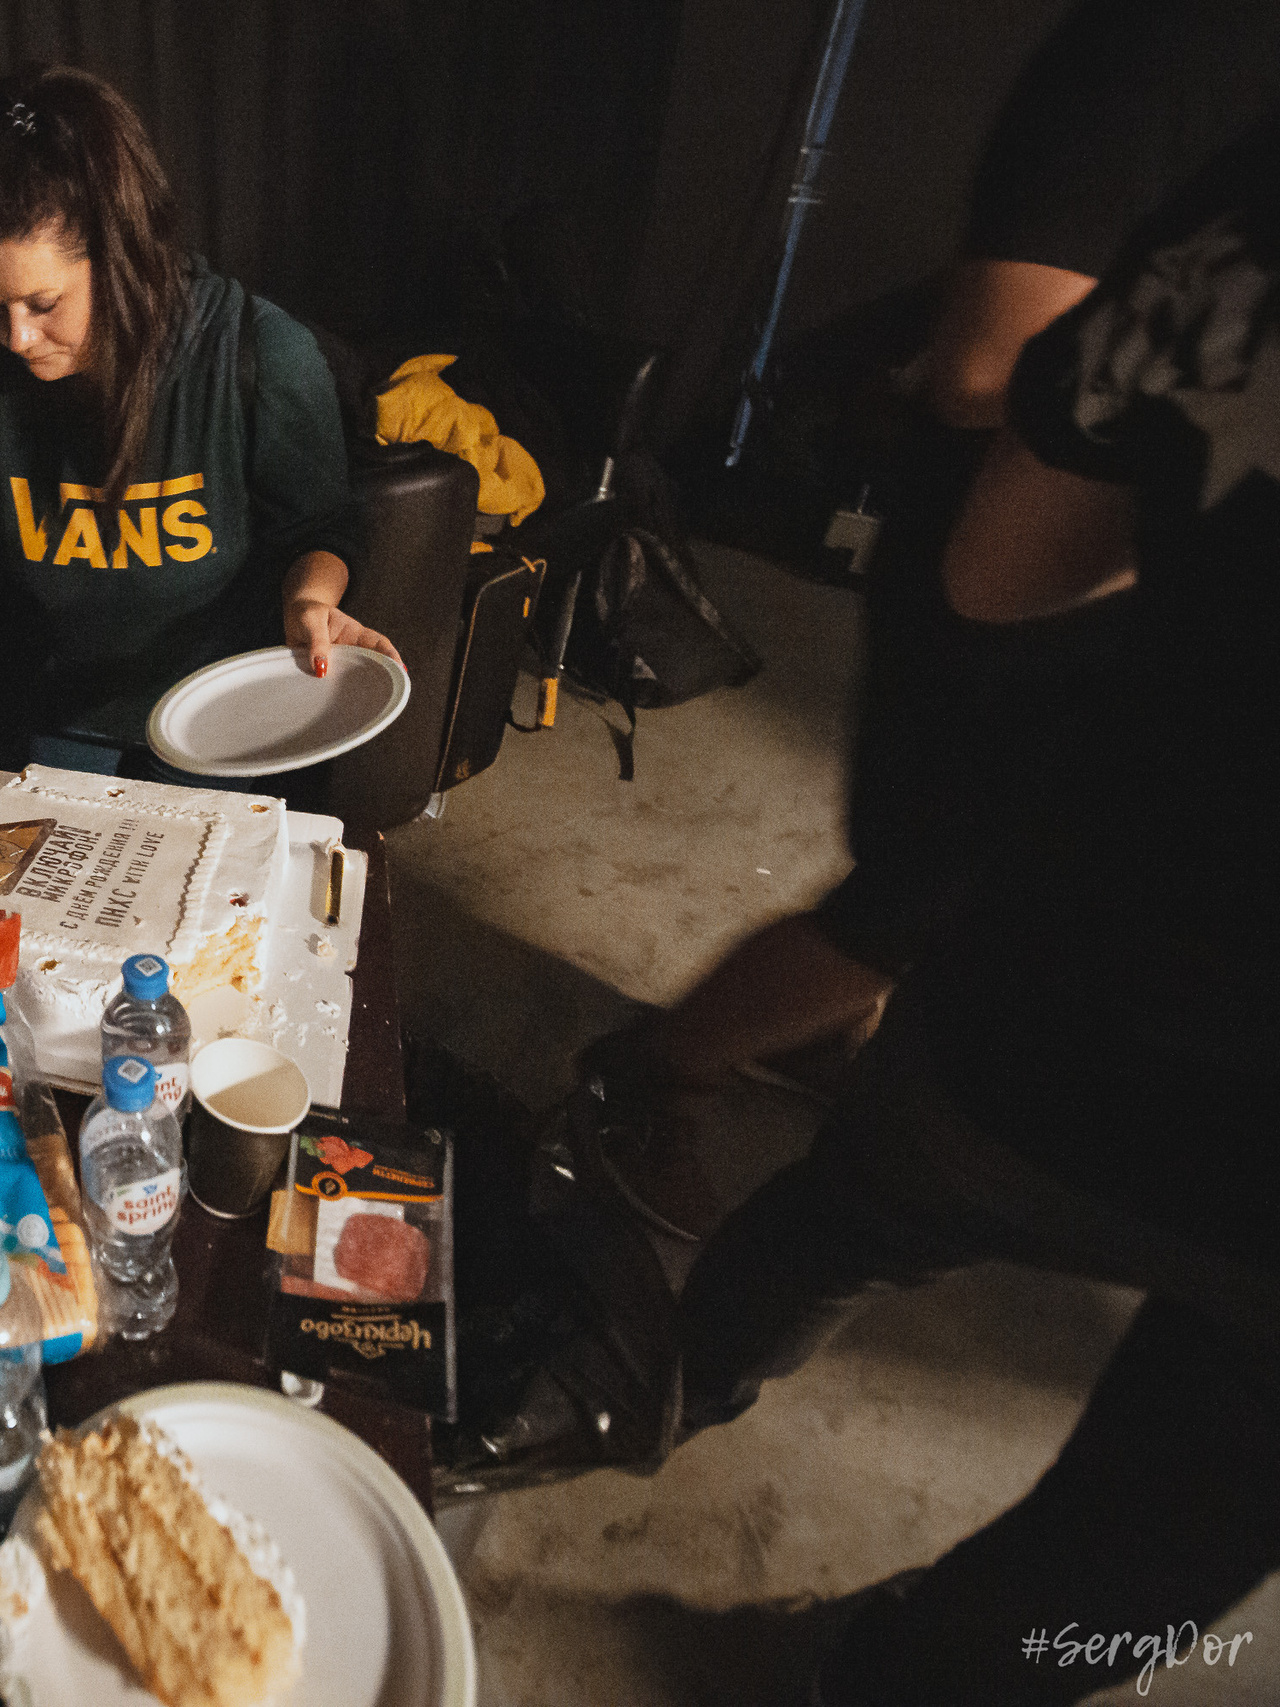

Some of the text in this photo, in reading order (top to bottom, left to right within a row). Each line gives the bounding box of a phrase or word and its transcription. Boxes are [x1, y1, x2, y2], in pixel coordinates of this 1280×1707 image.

[10, 473, 213, 569] VANS
[137, 831, 164, 859] LOVE
[124, 1186, 171, 1209] saint
[300, 1318, 432, 1349] Черкизово
